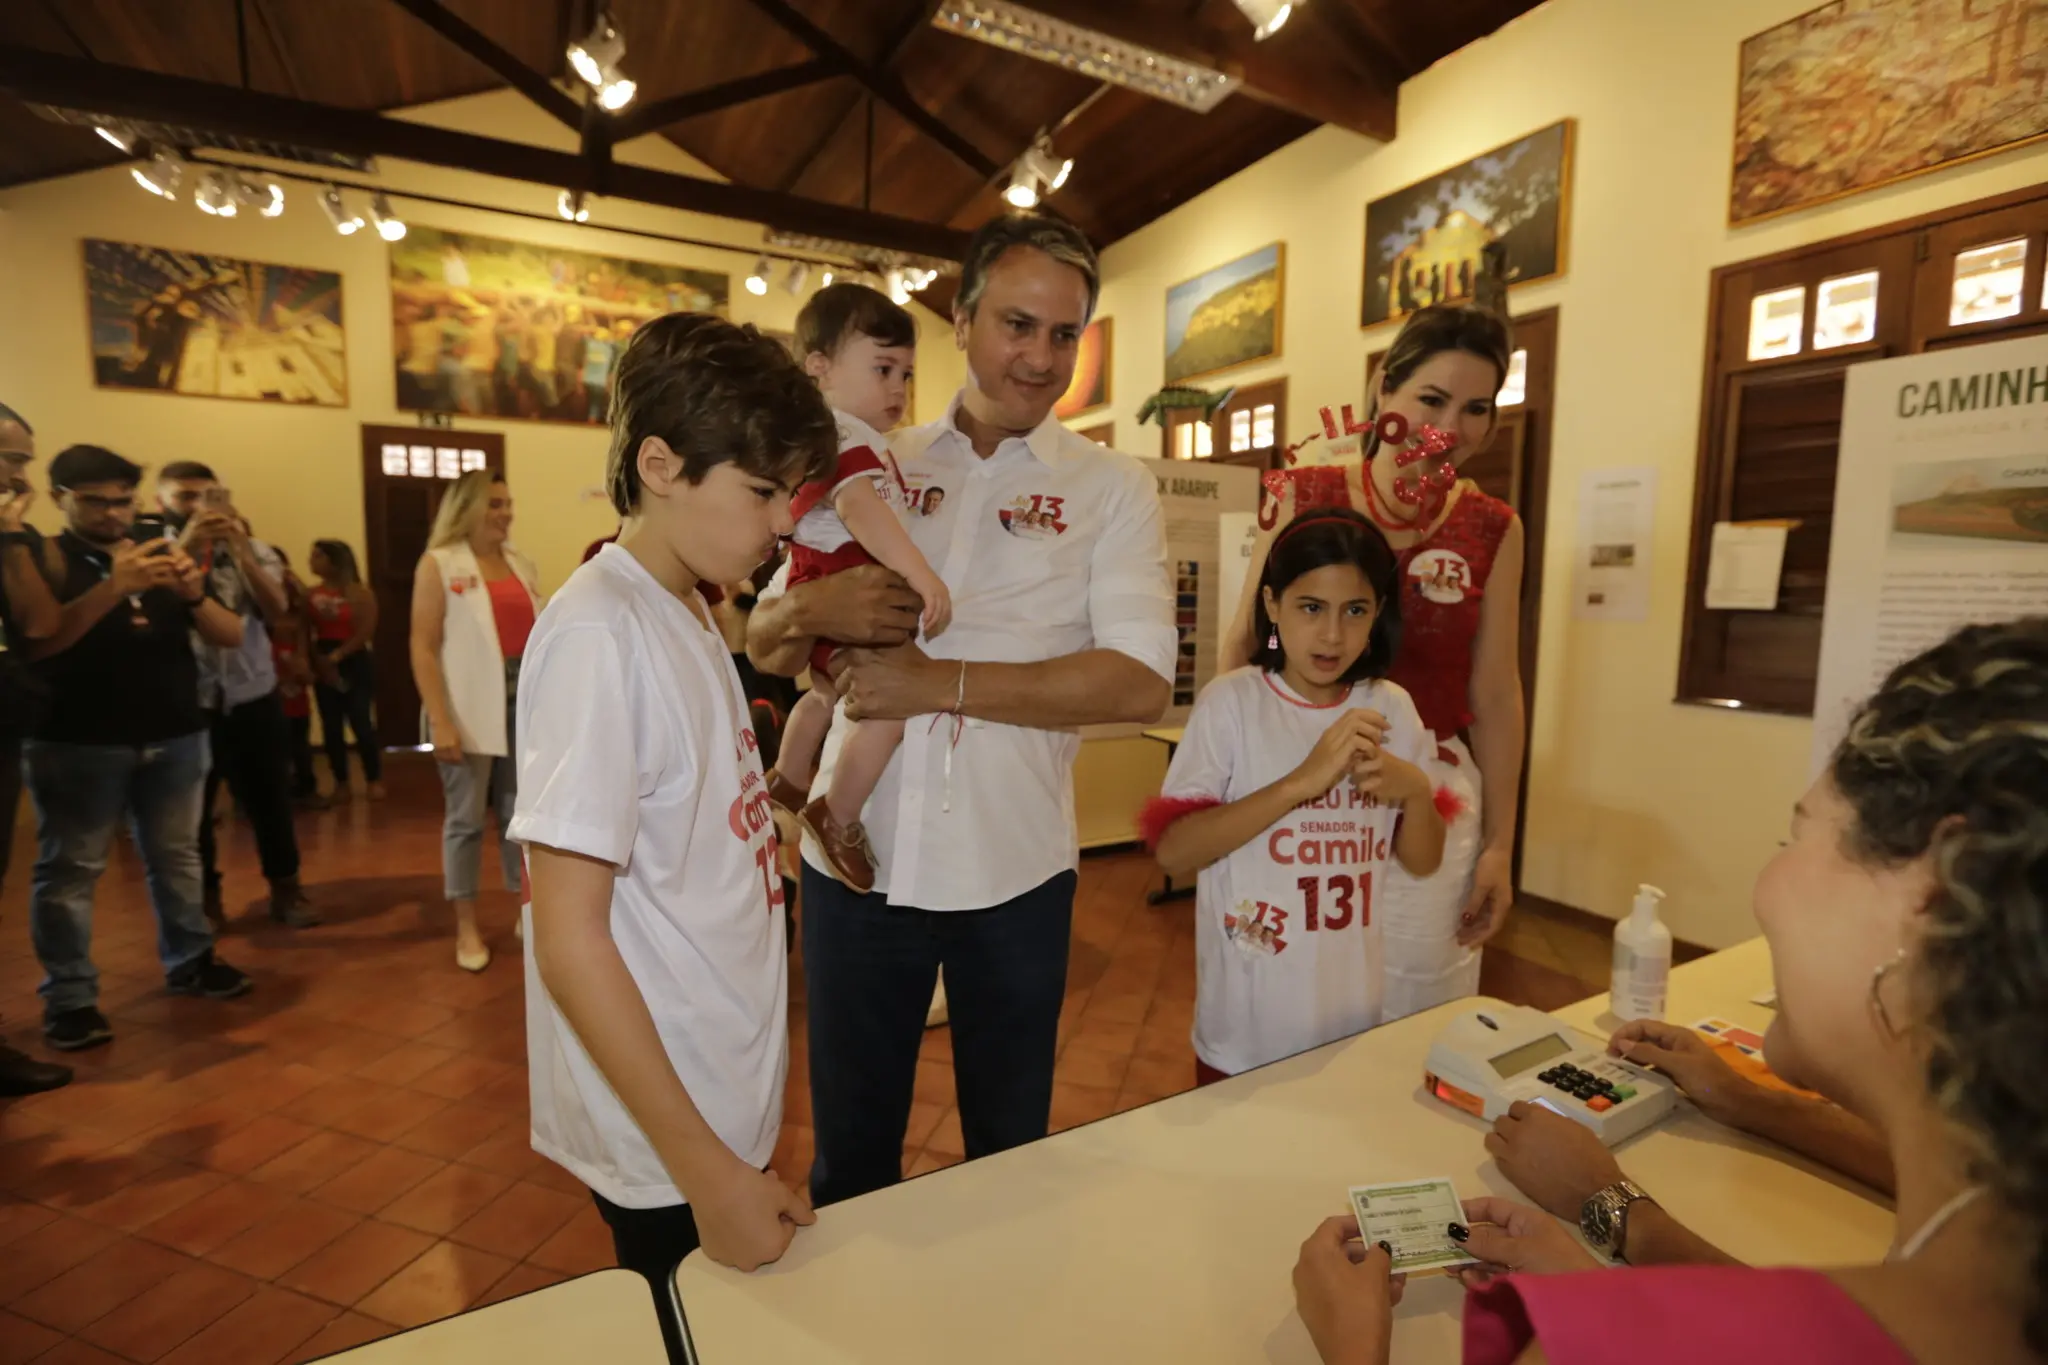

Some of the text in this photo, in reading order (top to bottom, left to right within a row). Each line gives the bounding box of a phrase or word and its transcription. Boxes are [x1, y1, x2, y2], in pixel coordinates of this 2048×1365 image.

[1171, 478, 1219, 499] ARARIPE
[1030, 494, 1065, 521] 13
[1434, 558, 1465, 585] 13
[1300, 821, 1356, 833] SENADOR
[1297, 872, 1373, 932] 131
[1256, 900, 1290, 936] 13
